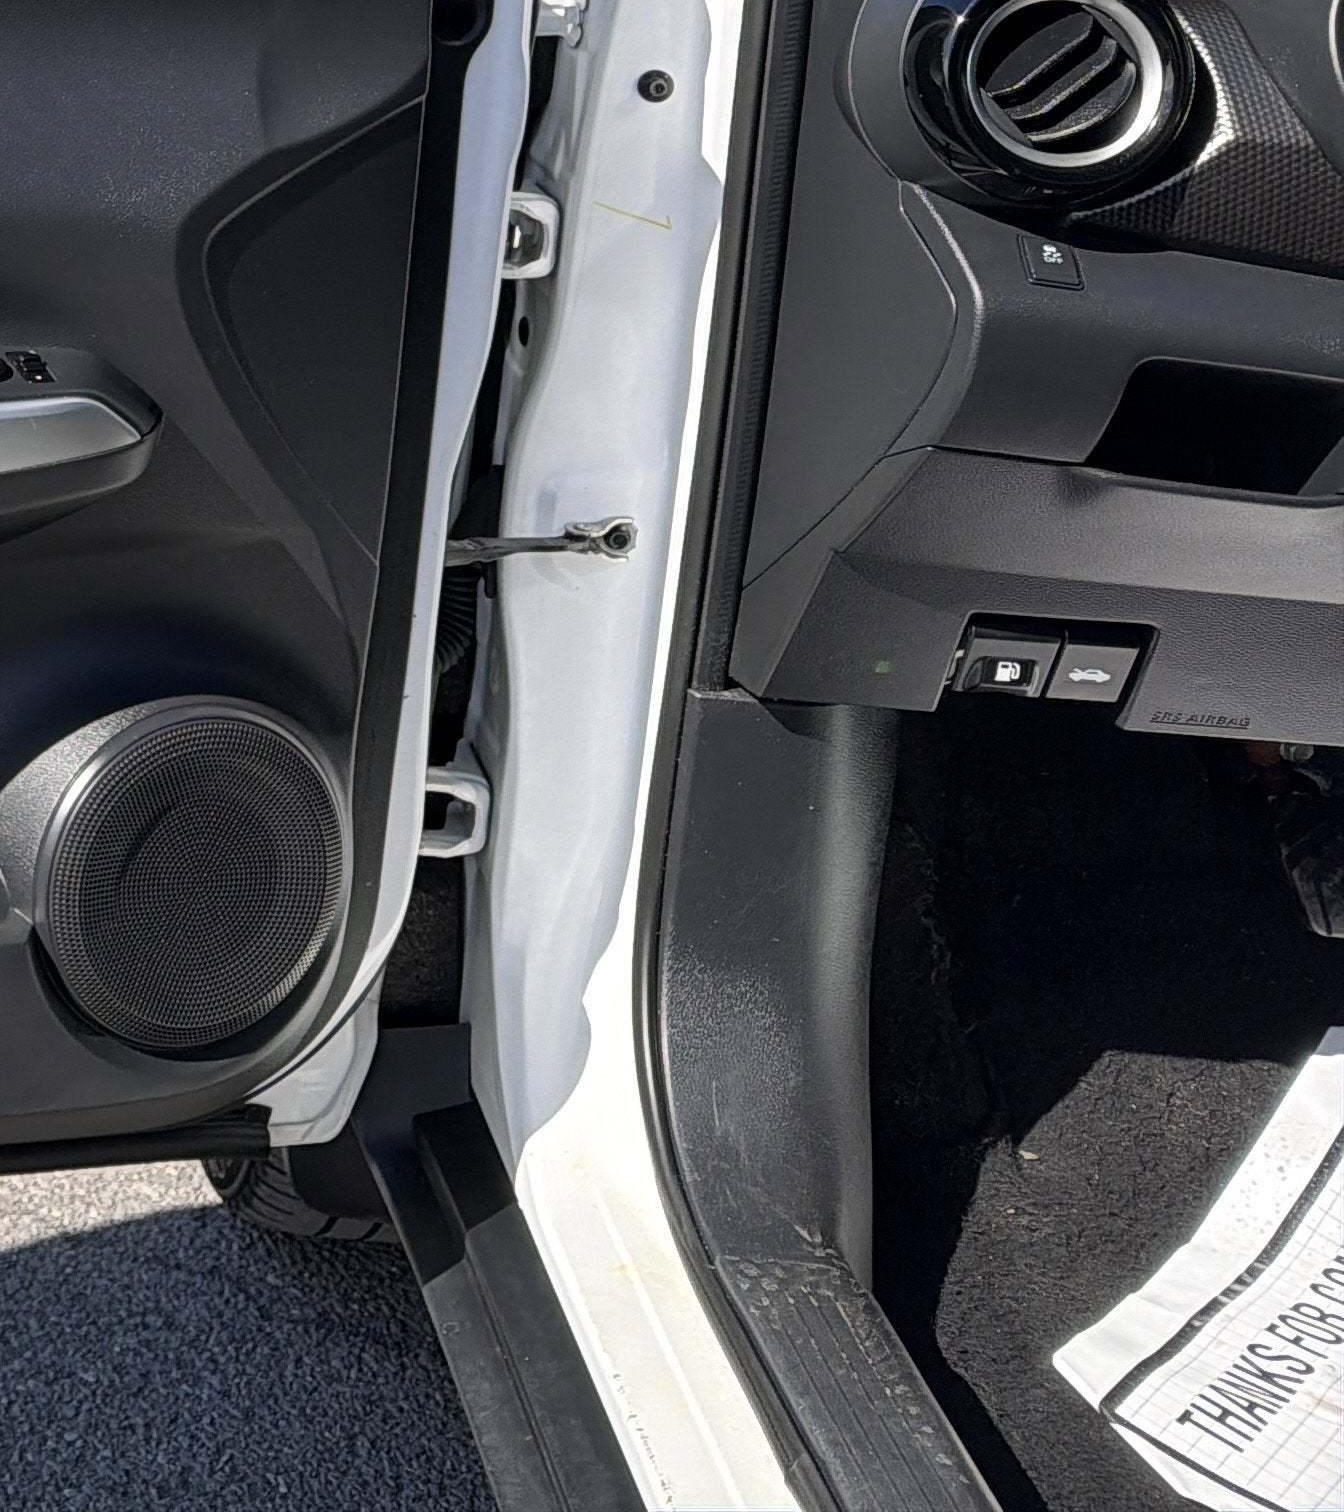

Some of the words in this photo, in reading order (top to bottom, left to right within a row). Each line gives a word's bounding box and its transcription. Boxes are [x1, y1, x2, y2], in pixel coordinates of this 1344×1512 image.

[1043, 256, 1063, 264] OFF
[1152, 711, 1183, 722] SRS
[1186, 714, 1251, 727] AIRBAG
[1175, 1343, 1315, 1453] THANKS
[1264, 1302, 1344, 1360] FOR
